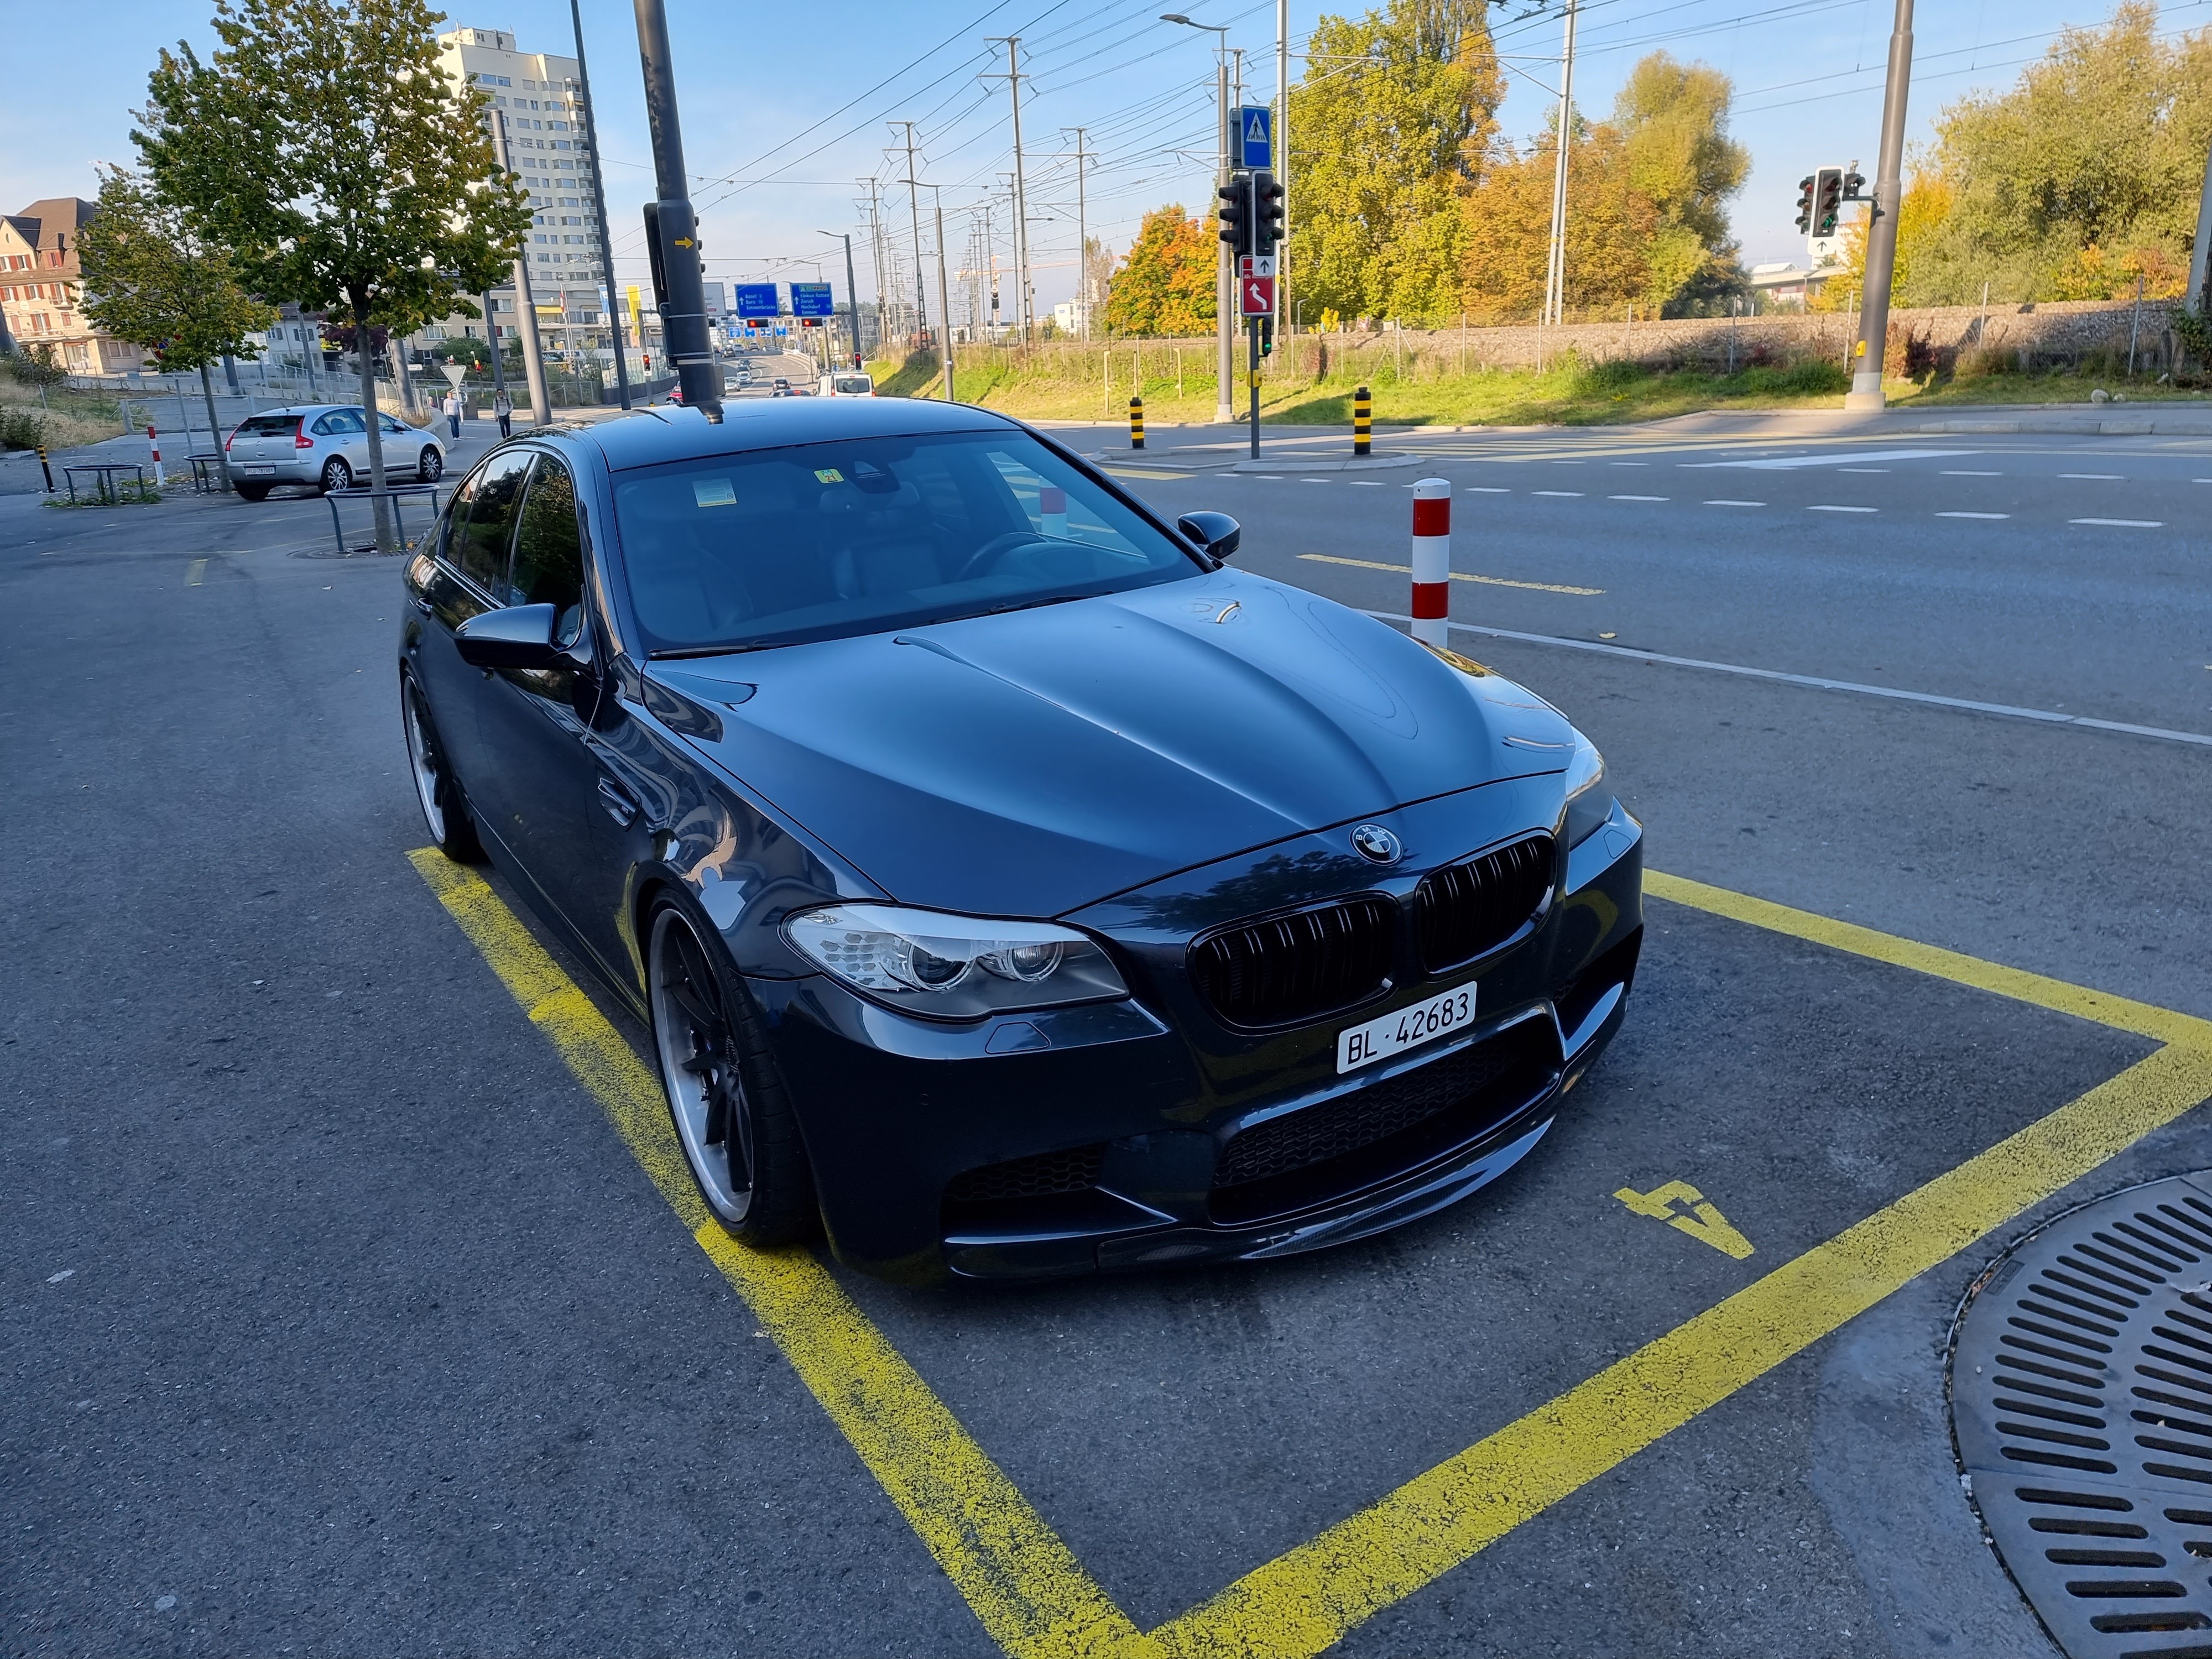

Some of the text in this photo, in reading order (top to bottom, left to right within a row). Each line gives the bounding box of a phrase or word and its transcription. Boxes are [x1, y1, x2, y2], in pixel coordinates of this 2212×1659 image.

[1353, 827, 1383, 841] BMW
[1348, 993, 1468, 1065] BL 42683
